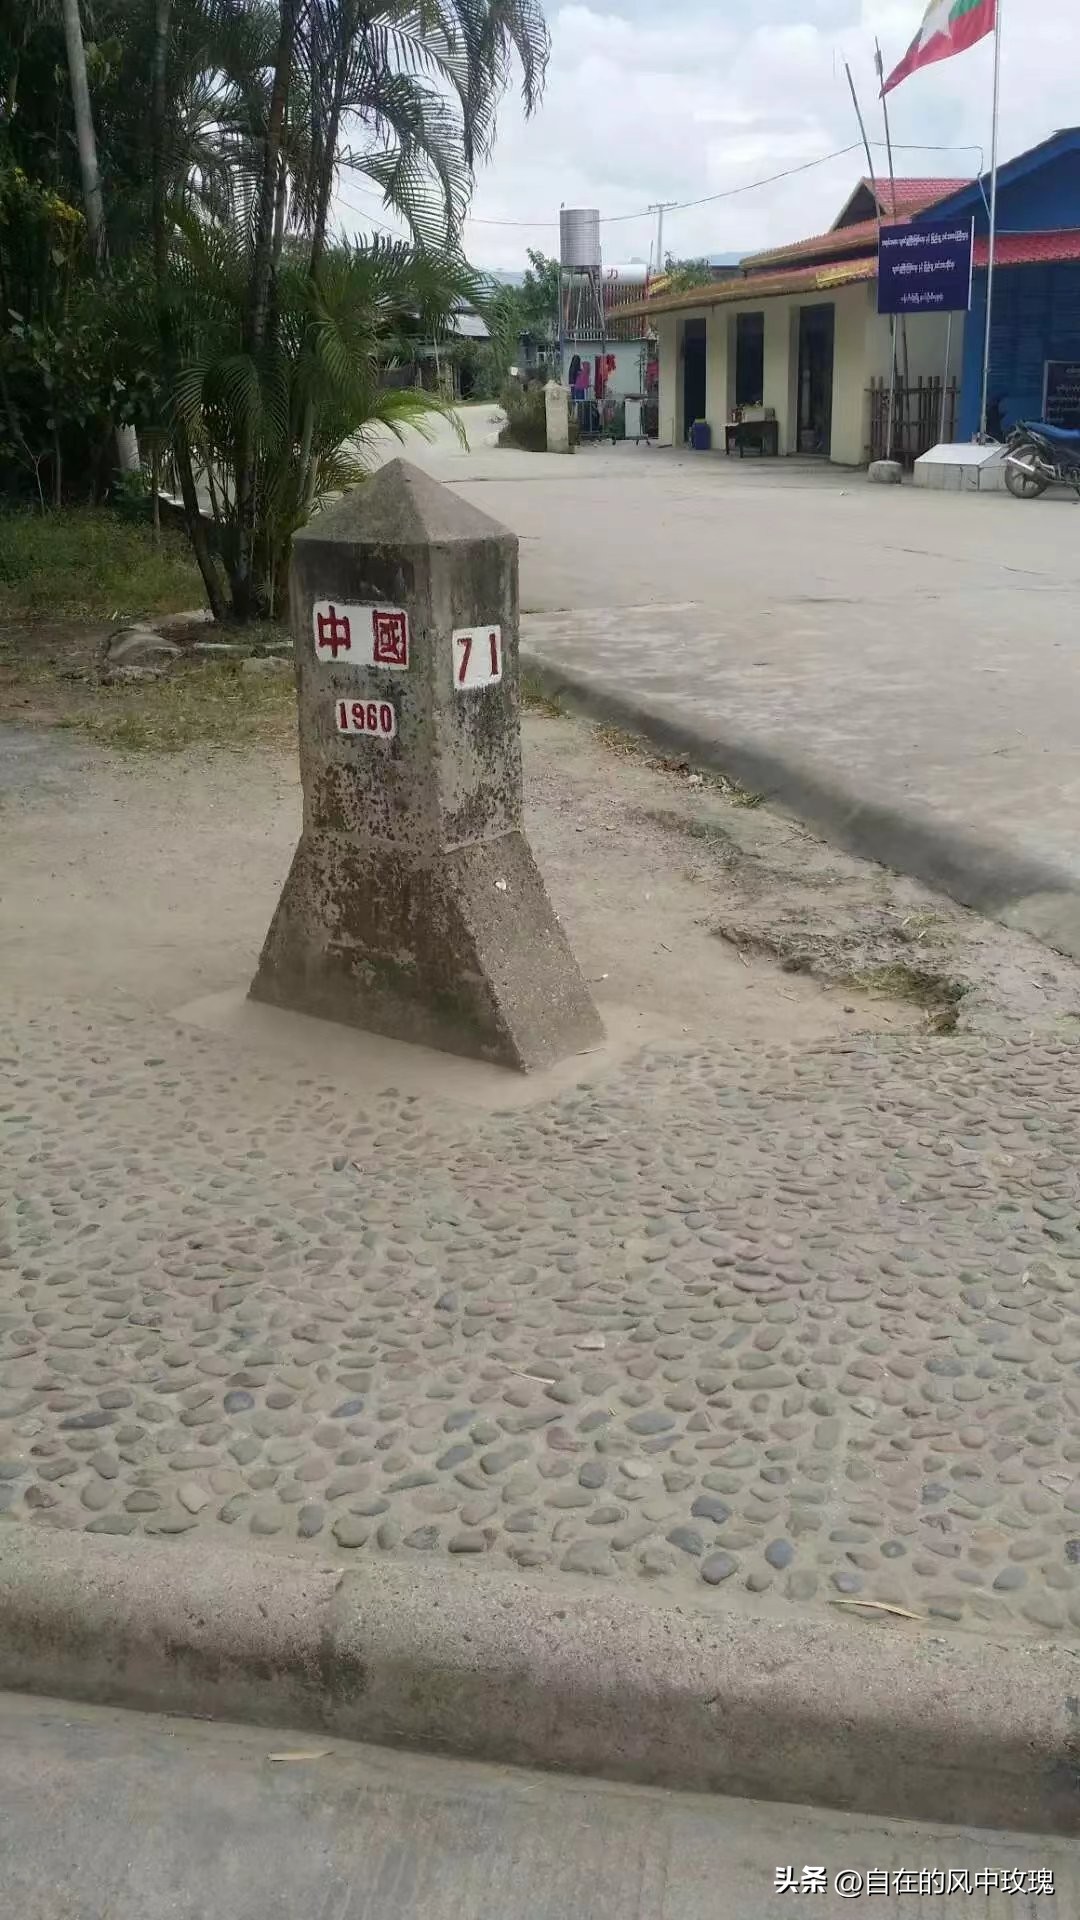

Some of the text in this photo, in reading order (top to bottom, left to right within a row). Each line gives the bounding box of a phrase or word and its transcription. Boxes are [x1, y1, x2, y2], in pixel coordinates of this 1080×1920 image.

[317, 604, 407, 665] 中國
[457, 632, 499, 683] 71
[338, 702, 393, 733] 1960
